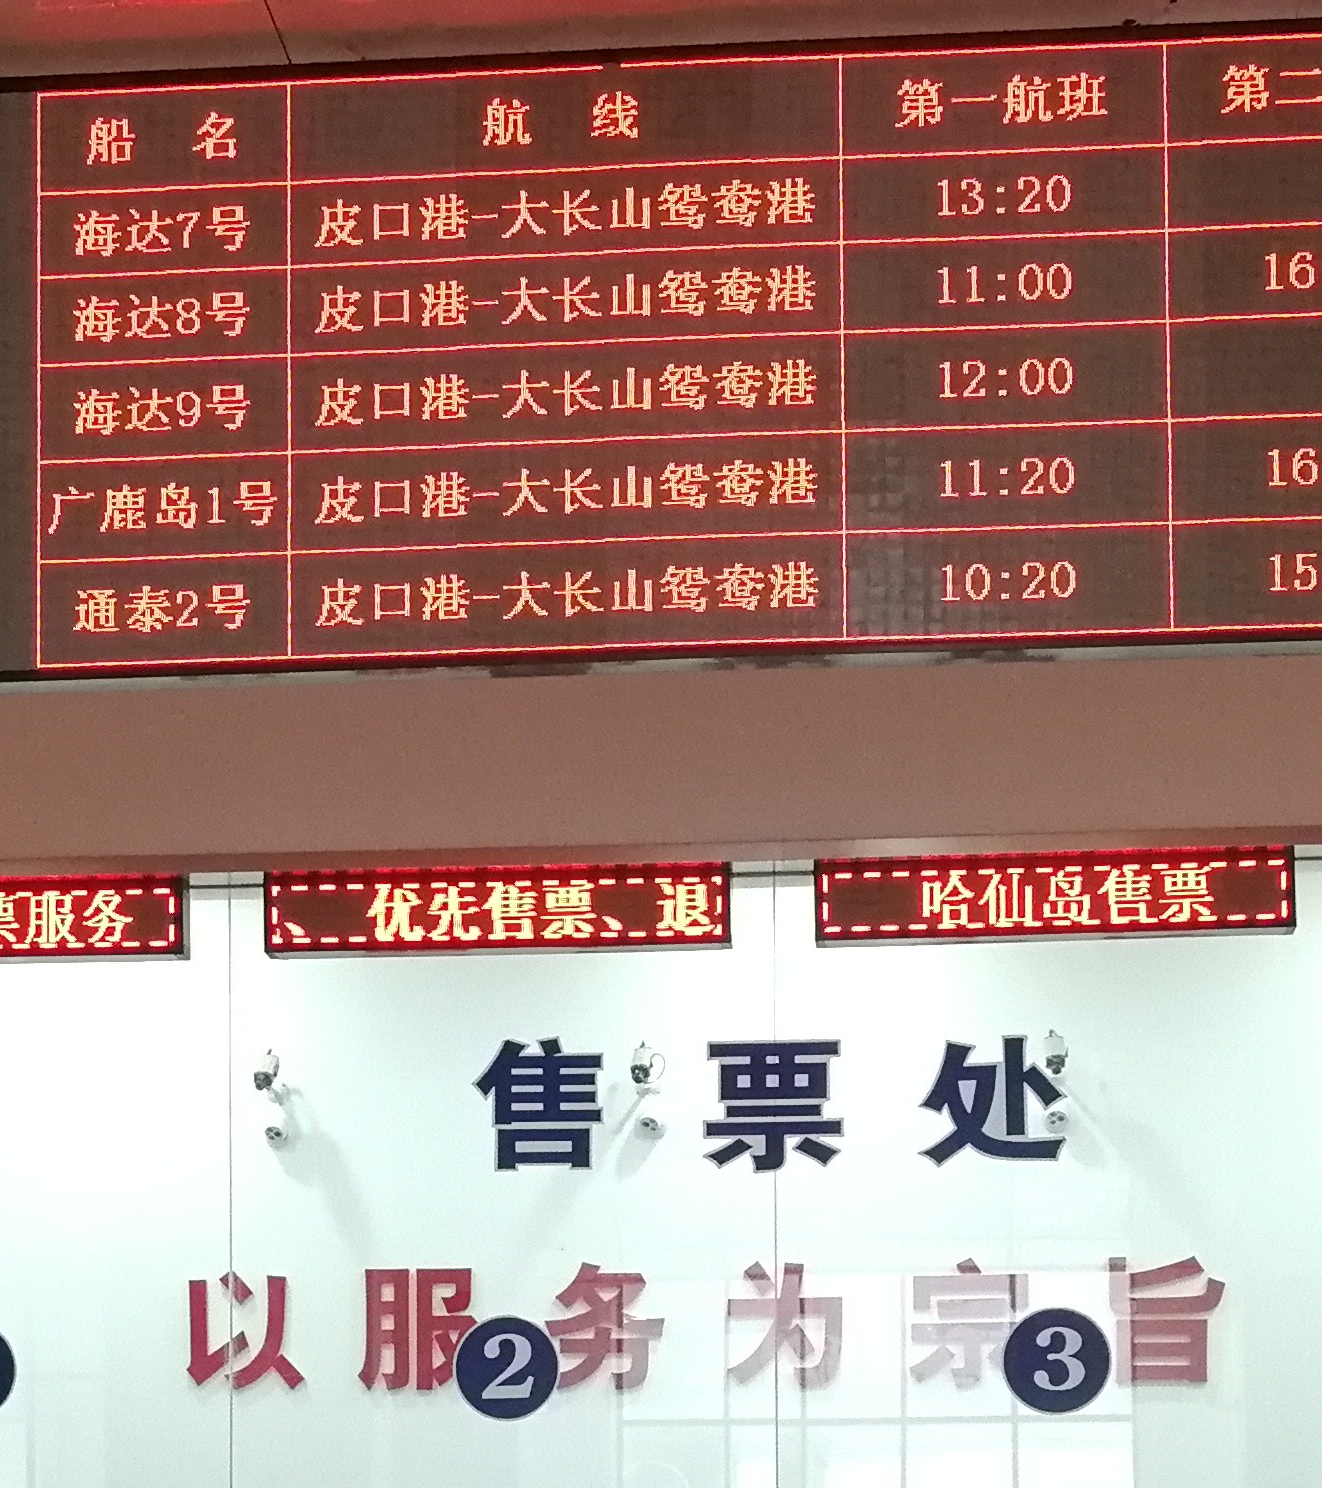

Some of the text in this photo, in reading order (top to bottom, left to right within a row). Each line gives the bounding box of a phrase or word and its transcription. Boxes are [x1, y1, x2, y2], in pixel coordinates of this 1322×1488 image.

[893, 71, 1109, 129] 第一航班
[72, 204, 252, 258] 海达7号
[936, 173, 1073, 217] 13:20
[72, 290, 252, 344] 海达8号
[936, 261, 1073, 305] 11:00
[72, 383, 252, 437] 海达9号
[938, 356, 1074, 399] 12:00
[46, 479, 279, 536] 广鹿岛1号
[939, 456, 1076, 498] 11:20
[72, 580, 252, 634] 通泰2号
[939, 559, 1077, 602] 10:20
[921, 867, 1215, 927] 哈仙岛售票
[472, 1035, 1068, 1173] 售票处
[481, 1332, 535, 1400] 2
[1032, 1326, 1086, 1391] 3
